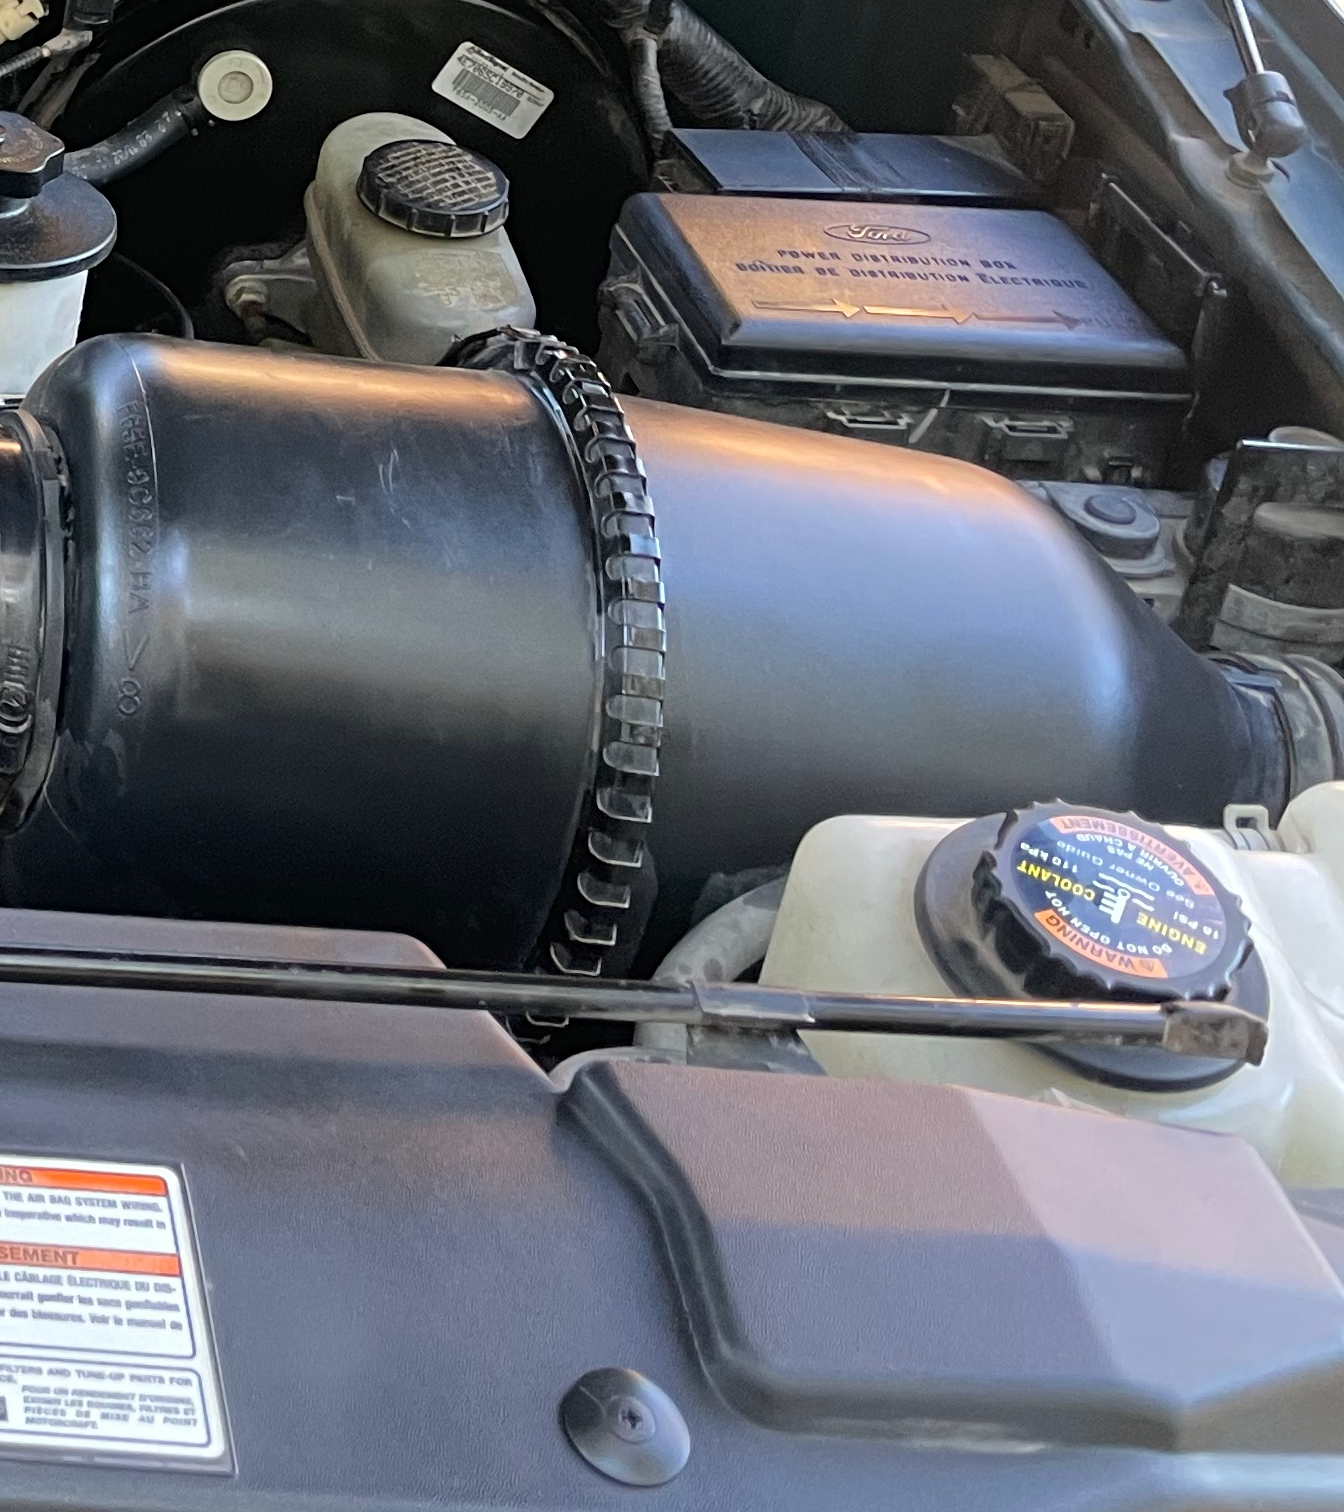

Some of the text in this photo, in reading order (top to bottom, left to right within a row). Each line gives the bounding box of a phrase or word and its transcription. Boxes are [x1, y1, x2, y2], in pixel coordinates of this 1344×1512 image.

[846, 222, 911, 242] Ford
[776, 249, 1017, 269] POWER DISTRIBUTION BOX
[815, 267, 840, 276] DE
[849, 268, 970, 283] DISTRIBUTION
[1020, 841, 1049, 862] kPa
[1056, 839, 1104, 866] Guide
[1051, 856, 1079, 874] 110
[1109, 863, 1161, 891] Owner
[1016, 858, 1208, 955] ENGINE COOLANT
[1173, 911, 1199, 930] PSI
[1070, 917, 1111, 945] OPEN
[1044, 914, 1135, 971] WARNING
[1116, 940, 1149, 955] NOT
